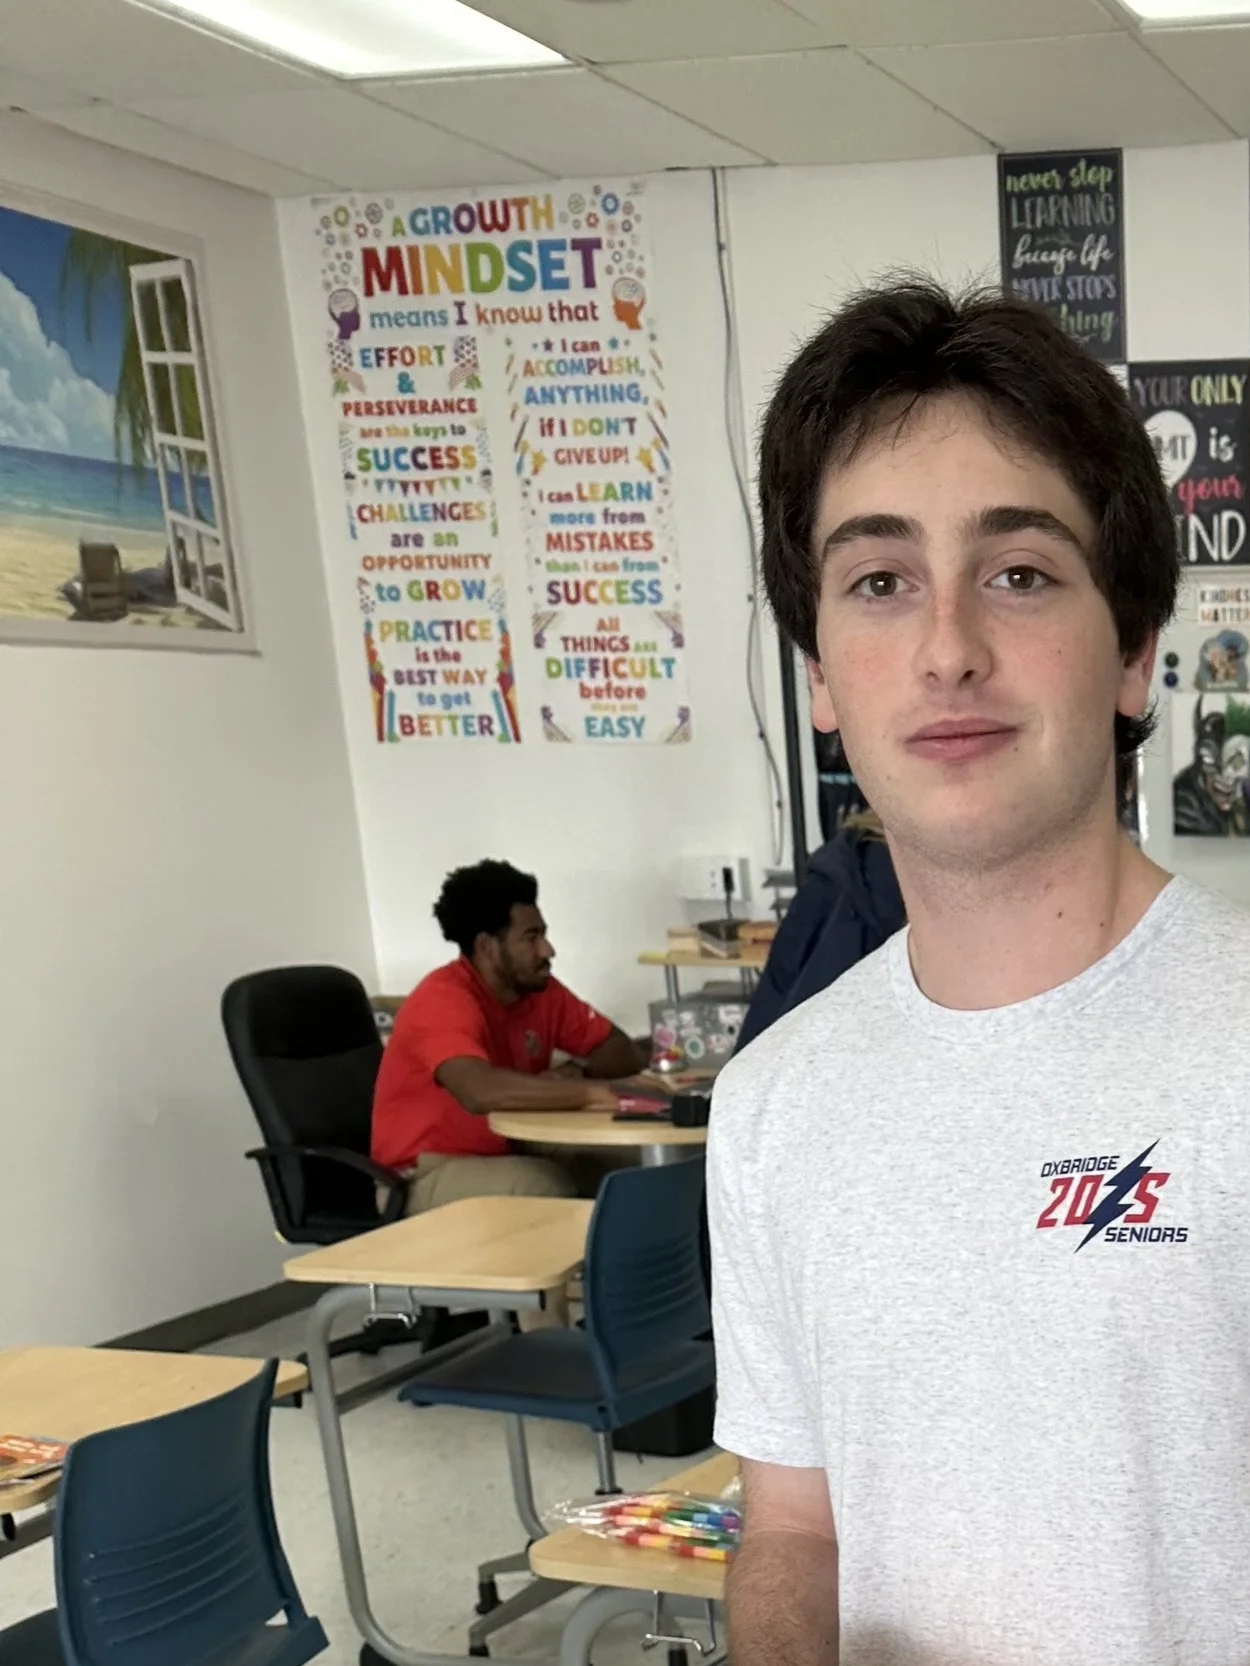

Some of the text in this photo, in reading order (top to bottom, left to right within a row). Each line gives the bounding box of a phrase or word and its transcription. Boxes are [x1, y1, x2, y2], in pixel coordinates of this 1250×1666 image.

[1006, 158, 1114, 192] never stop
[393, 195, 555, 236] A GROWTH
[1011, 192, 1115, 229] LEARNING
[1080, 233, 1114, 271] life
[362, 238, 602, 297] MINDSET
[1066, 274, 1117, 300] STOPS
[370, 300, 599, 329] means I know that
[561, 337, 600, 353] I can
[360, 345, 446, 369] EFFORT
[397, 371, 415, 394] &
[1134, 373, 1248, 407] YOUR ONLY
[342, 397, 478, 417] PERSEVERANCE
[359, 426, 382, 439] are
[412, 423, 447, 440] keys
[450, 423, 466, 436] to
[560, 418, 566, 437] I
[572, 417, 637, 436] DON'T
[554, 446, 629, 465] GIVE UP!
[1209, 426, 1237, 463] is
[356, 444, 477, 473] SUCCESS
[547, 491, 574, 503] can
[576, 481, 653, 503] LEARN
[1177, 473, 1246, 516] your
[356, 502, 487, 524] CHALLENGES
[549, 507, 646, 525] more from
[391, 532, 459, 548] are an
[545, 530, 654, 553] MISTAKES
[1175, 510, 1246, 563] IND
[362, 554, 492, 571] OPPORTUNITY
[622, 557, 660, 572] from
[375, 579, 487, 602] to GROW
[546, 579, 663, 605] SUCCESS
[379, 619, 493, 643] PRACTICE
[560, 635, 630, 652] THINGS
[415, 647, 461, 664] is the
[393, 669, 487, 686] BEST WAY
[545, 656, 676, 679] DIFFICULT
[578, 680, 646, 699] before
[417, 692, 471, 711] to get
[399, 713, 494, 737] BETTER
[584, 716, 645, 738] EASY
[1040, 1155, 1120, 1178] OXBRIDGE
[1104, 1227, 1188, 1243] SENIORS
